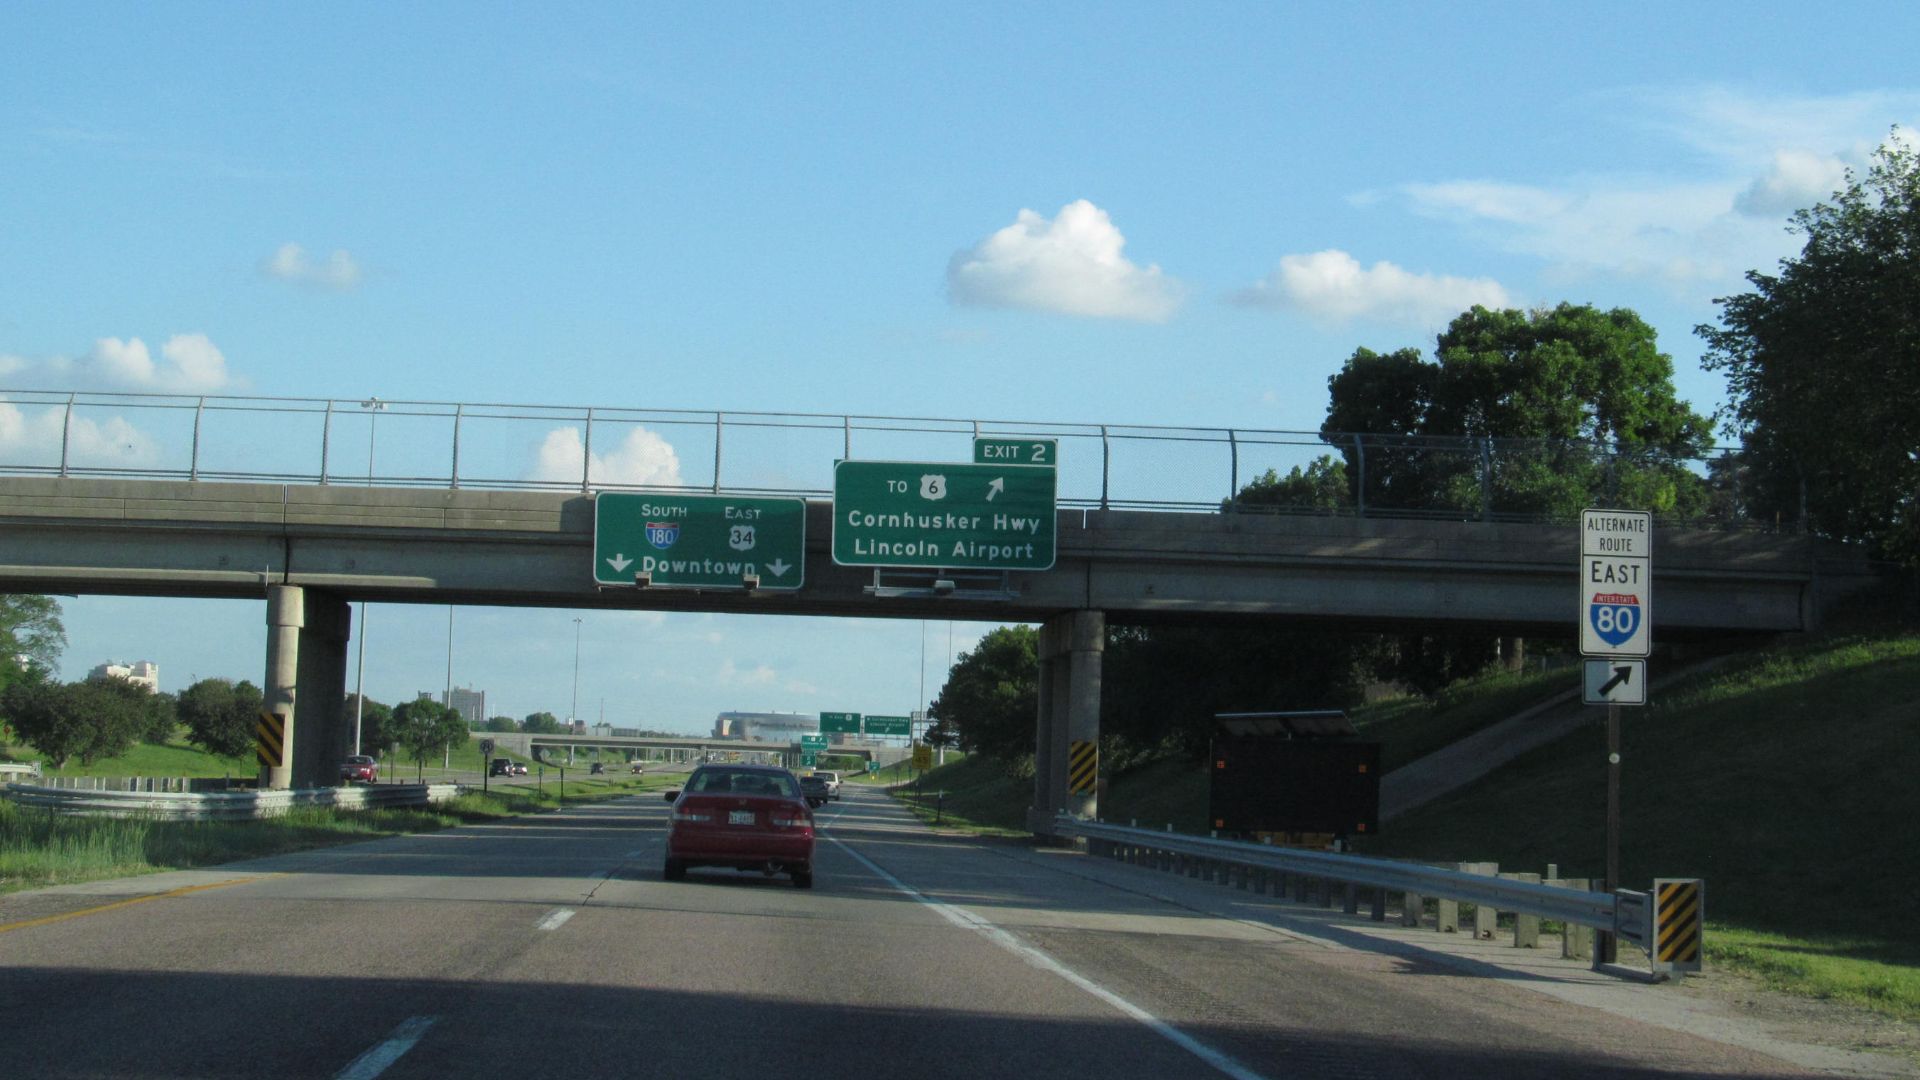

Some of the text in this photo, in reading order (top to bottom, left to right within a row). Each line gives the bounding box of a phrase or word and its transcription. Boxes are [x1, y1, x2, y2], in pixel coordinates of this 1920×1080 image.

[983, 443, 1046, 462] EXIT 2
[887, 480, 938, 494] TO 6
[848, 510, 1040, 534] Cornhusker Hwy
[1587, 517, 1645, 533] ALTERNATE
[652, 531, 673, 544] 180
[731, 532, 753, 545] 34
[1600, 538, 1632, 551] ROUTE
[855, 538, 1033, 560] Lincoln Airport
[643, 556, 756, 575] Downtown
[1597, 595, 1635, 604] INTERSTATE
[1597, 606, 1633, 633] 80
